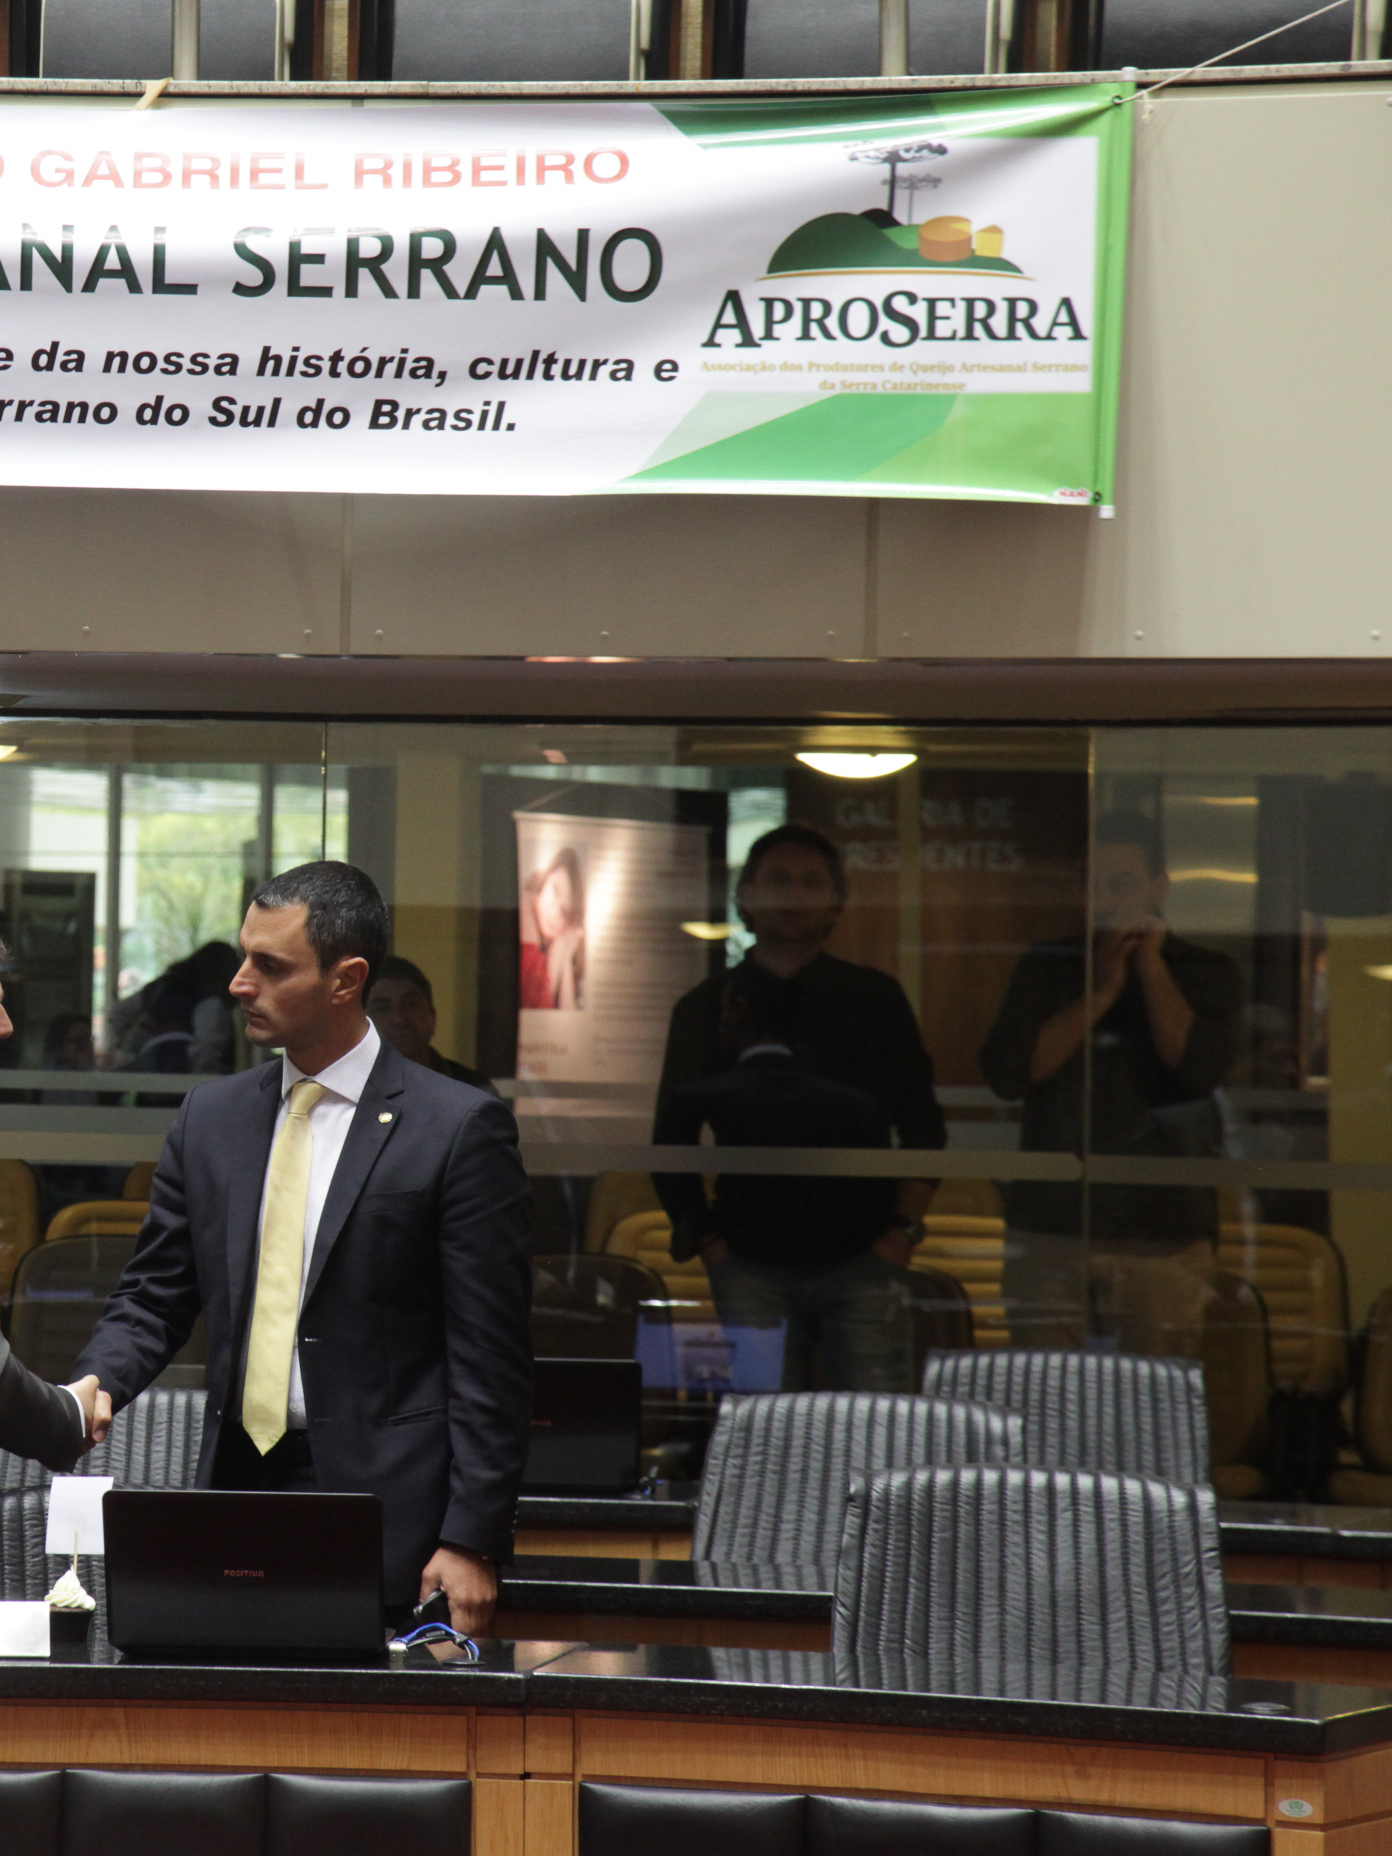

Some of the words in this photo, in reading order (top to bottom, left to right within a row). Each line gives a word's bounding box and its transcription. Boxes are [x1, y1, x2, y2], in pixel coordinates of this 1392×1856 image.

[31, 148, 329, 190] GABRIEL
[354, 147, 631, 189] RIBEIRO
[231, 226, 664, 304] SERRANO
[30, 340, 86, 373] da
[101, 350, 240, 377] nossa
[255, 345, 448, 388] história,
[468, 348, 635, 382] cultura
[653, 358, 679, 382] e
[700, 361, 776, 374] Associação
[779, 361, 803, 373] dos
[807, 361, 885, 373] Produtores
[888, 361, 906, 373] de
[908, 361, 955, 375] Queijo
[958, 361, 1028, 373] Artesanal
[1031, 361, 1089, 373] Serrano
[818, 379, 836, 391] da
[839, 379, 878, 391] Serra
[881, 379, 967, 391] Catarinense
[135, 394, 190, 427] do
[207, 395, 283, 428] Sul
[296, 397, 351, 430] do
[368, 398, 516, 432] Brasil.
